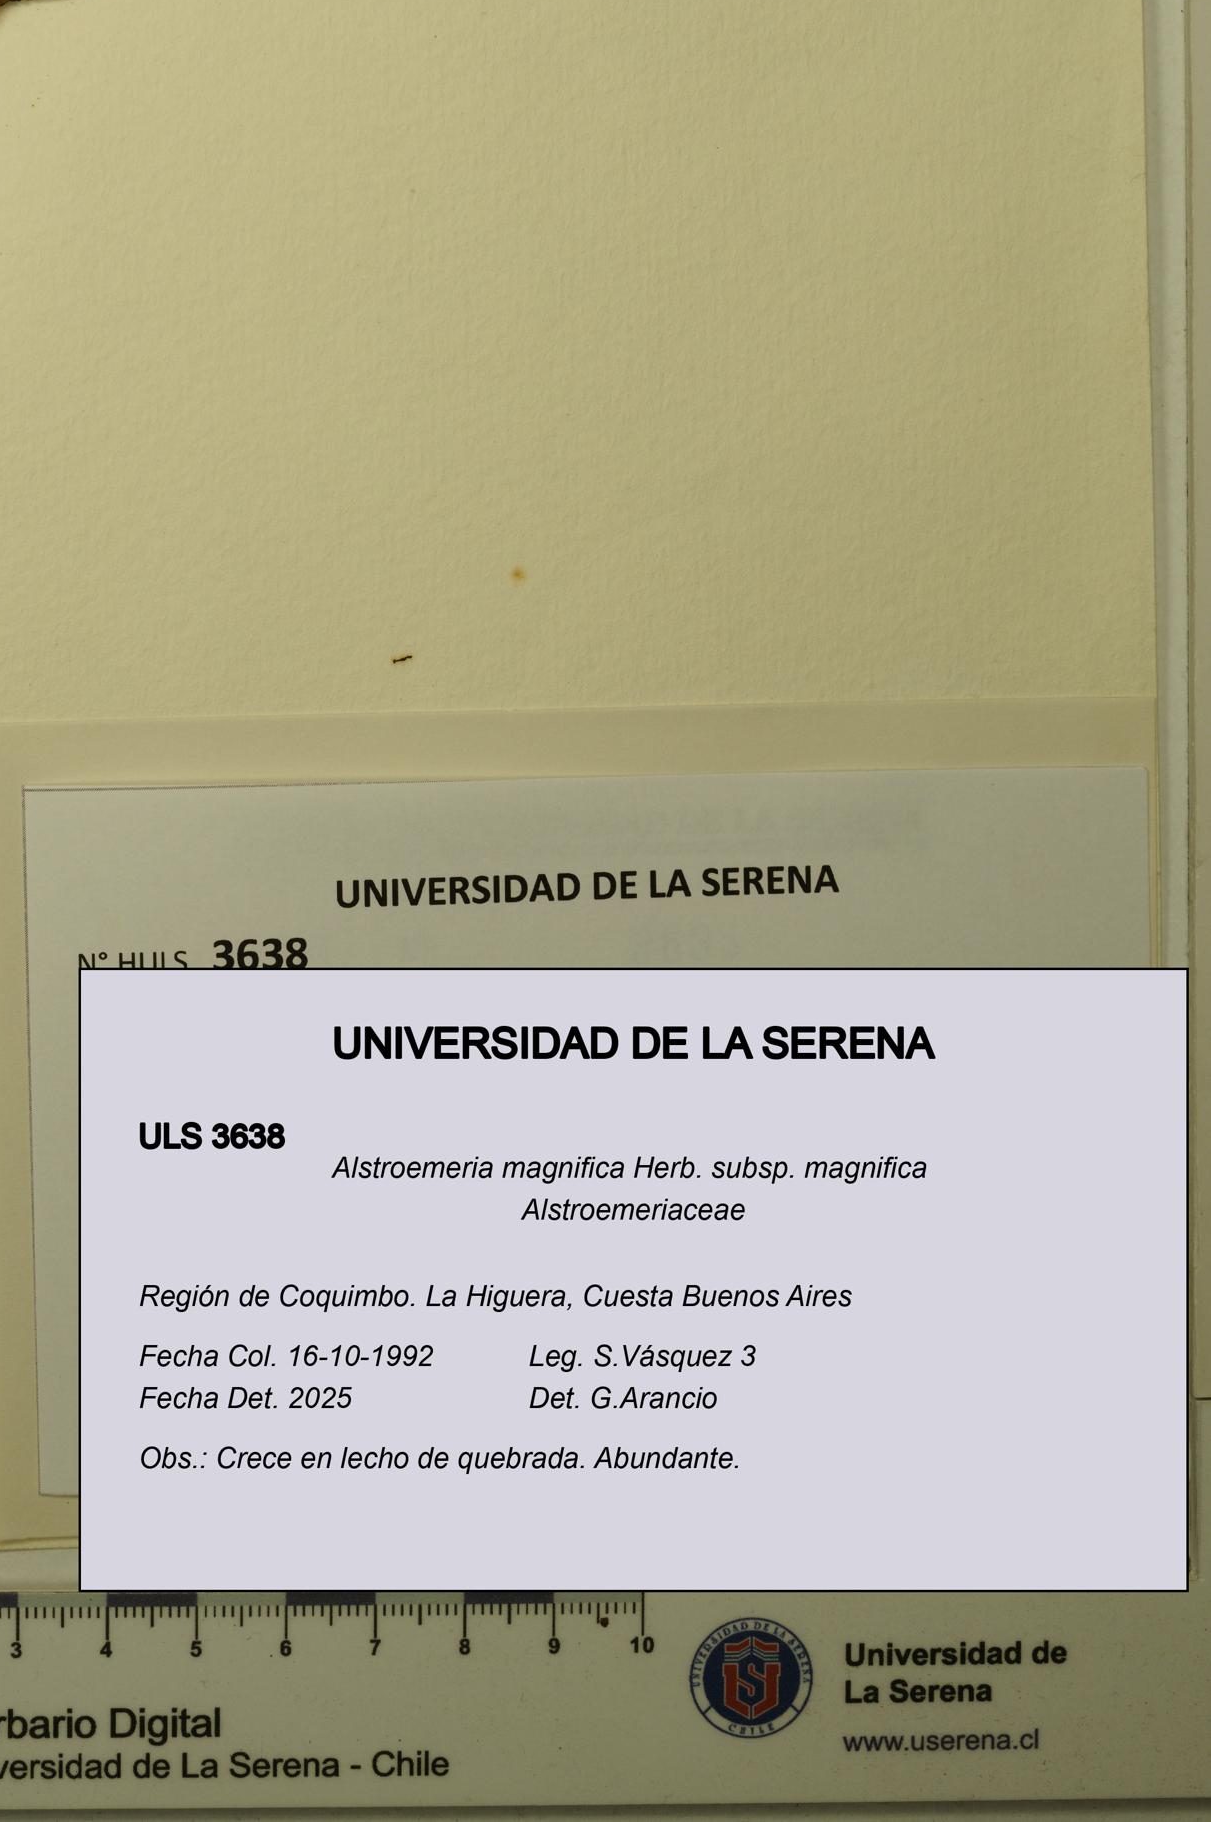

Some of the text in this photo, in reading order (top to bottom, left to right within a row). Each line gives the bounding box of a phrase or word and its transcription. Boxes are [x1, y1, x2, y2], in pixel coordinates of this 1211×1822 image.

[336, 864, 842, 910] UNIVERSIDAD DE LA SERENA
[213, 937, 309, 968] 3638
[10, 1642, 22, 1657] 3
[99, 1641, 113, 1657] 4
[191, 1641, 203, 1657] 5
[279, 1640, 292, 1656] 6
[369, 1639, 382, 1655] 7
[458, 1639, 471, 1655] 8
[547, 1638, 561, 1654] 9
[630, 1637, 655, 1653] 10
[845, 1640, 1068, 1667] Universidad de
[845, 1679, 993, 1704] La Serena
[110, 1707, 222, 1747] Digital
[843, 1729, 1039, 1751] www.userena.cl
[133, 1753, 171, 1779] de
[182, 1753, 219, 1778] La
[230, 1752, 340, 1778] Serena
[372, 1751, 450, 1778] Chile
